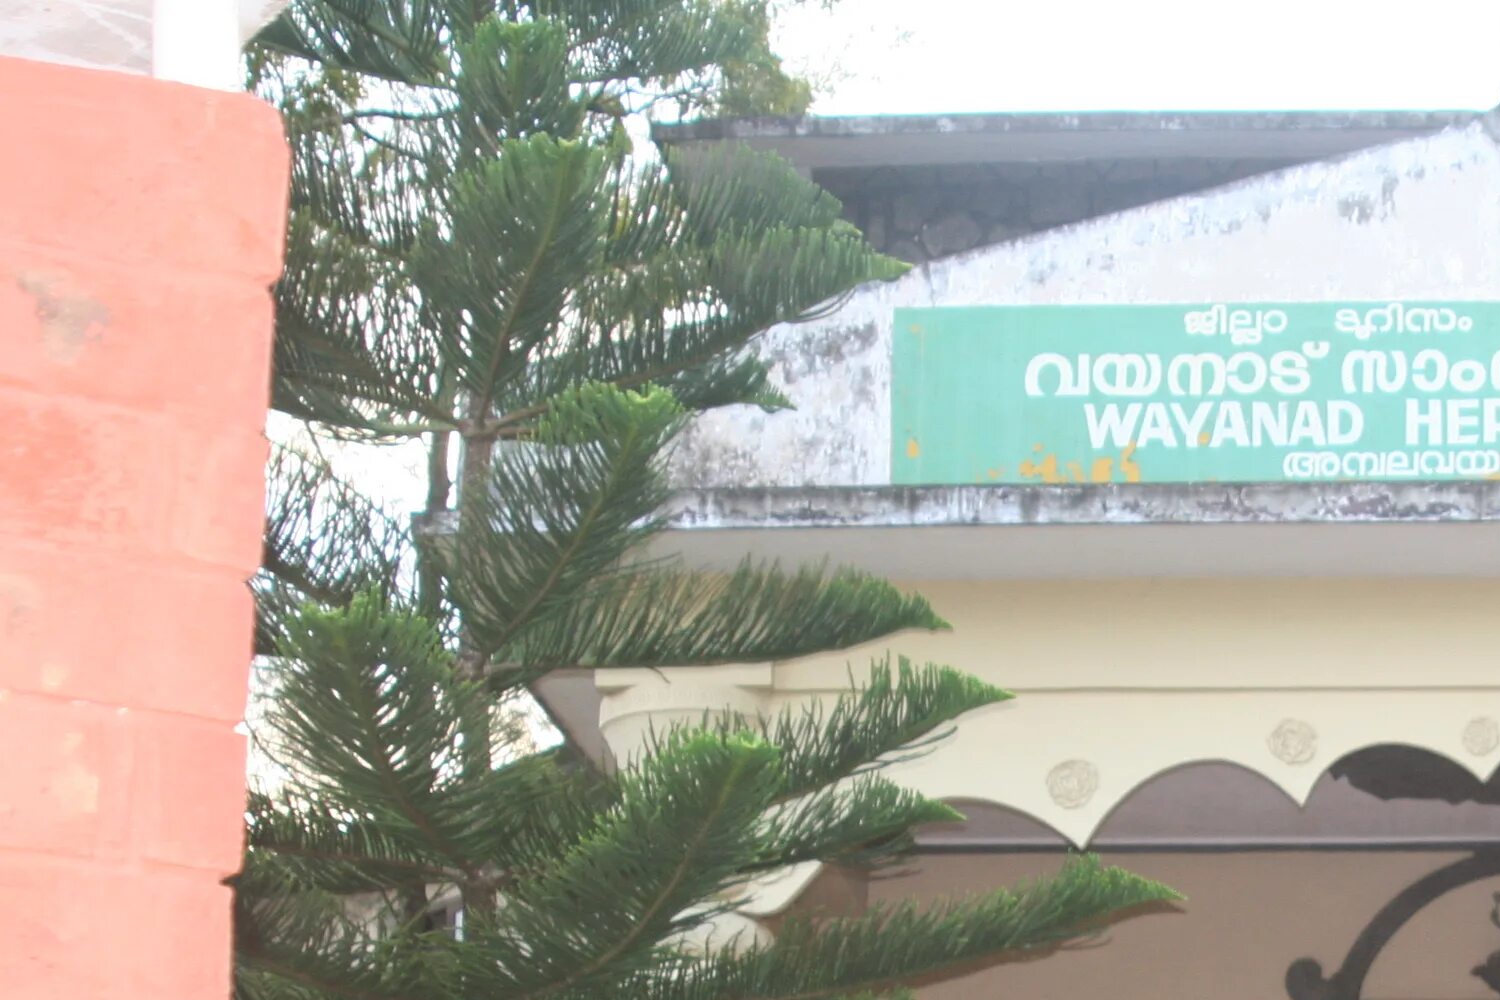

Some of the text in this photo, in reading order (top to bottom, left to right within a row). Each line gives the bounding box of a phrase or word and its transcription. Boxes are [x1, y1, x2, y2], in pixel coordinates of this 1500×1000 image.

[1184, 303, 1288, 345] ജില്ലാ
[1334, 302, 1473, 340] ടൂറിസം
[1024, 340, 1330, 396] വയനാട്
[1084, 399, 1364, 449] WAYANAD
